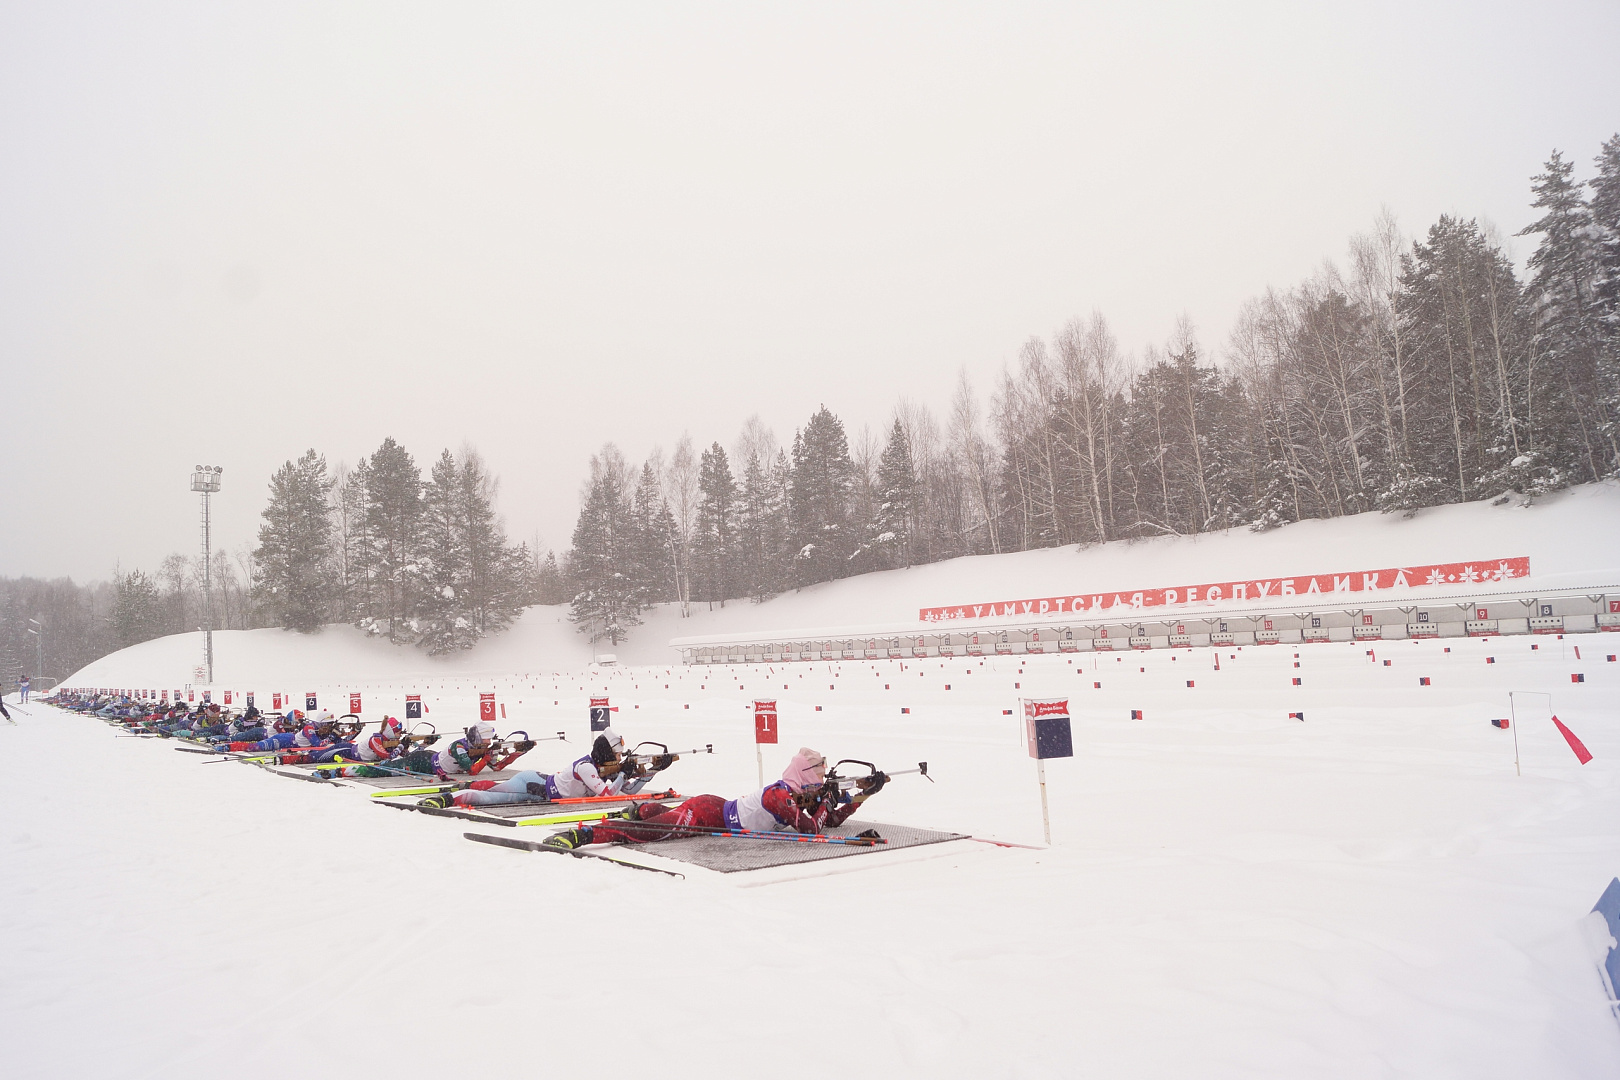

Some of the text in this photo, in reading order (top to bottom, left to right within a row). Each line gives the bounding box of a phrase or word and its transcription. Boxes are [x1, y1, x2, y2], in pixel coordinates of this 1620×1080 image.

[1165, 571, 1410, 608] РЕСПУБЛИКА
[1543, 606, 1550, 615] 8
[1612, 602, 1619, 611] 7
[1419, 613, 1428, 621] 10
[1479, 610, 1486, 618] 9
[1264, 622, 1272, 630] 13
[1312, 619, 1320, 627] 12
[309, 697, 315, 706] 6
[352, 699, 359, 708] 5
[410, 702, 418, 712] 4
[484, 702, 492, 713] 3
[596, 708, 605, 722] 2
[762, 715, 771, 731] 1
[729, 814, 739, 824] 31
